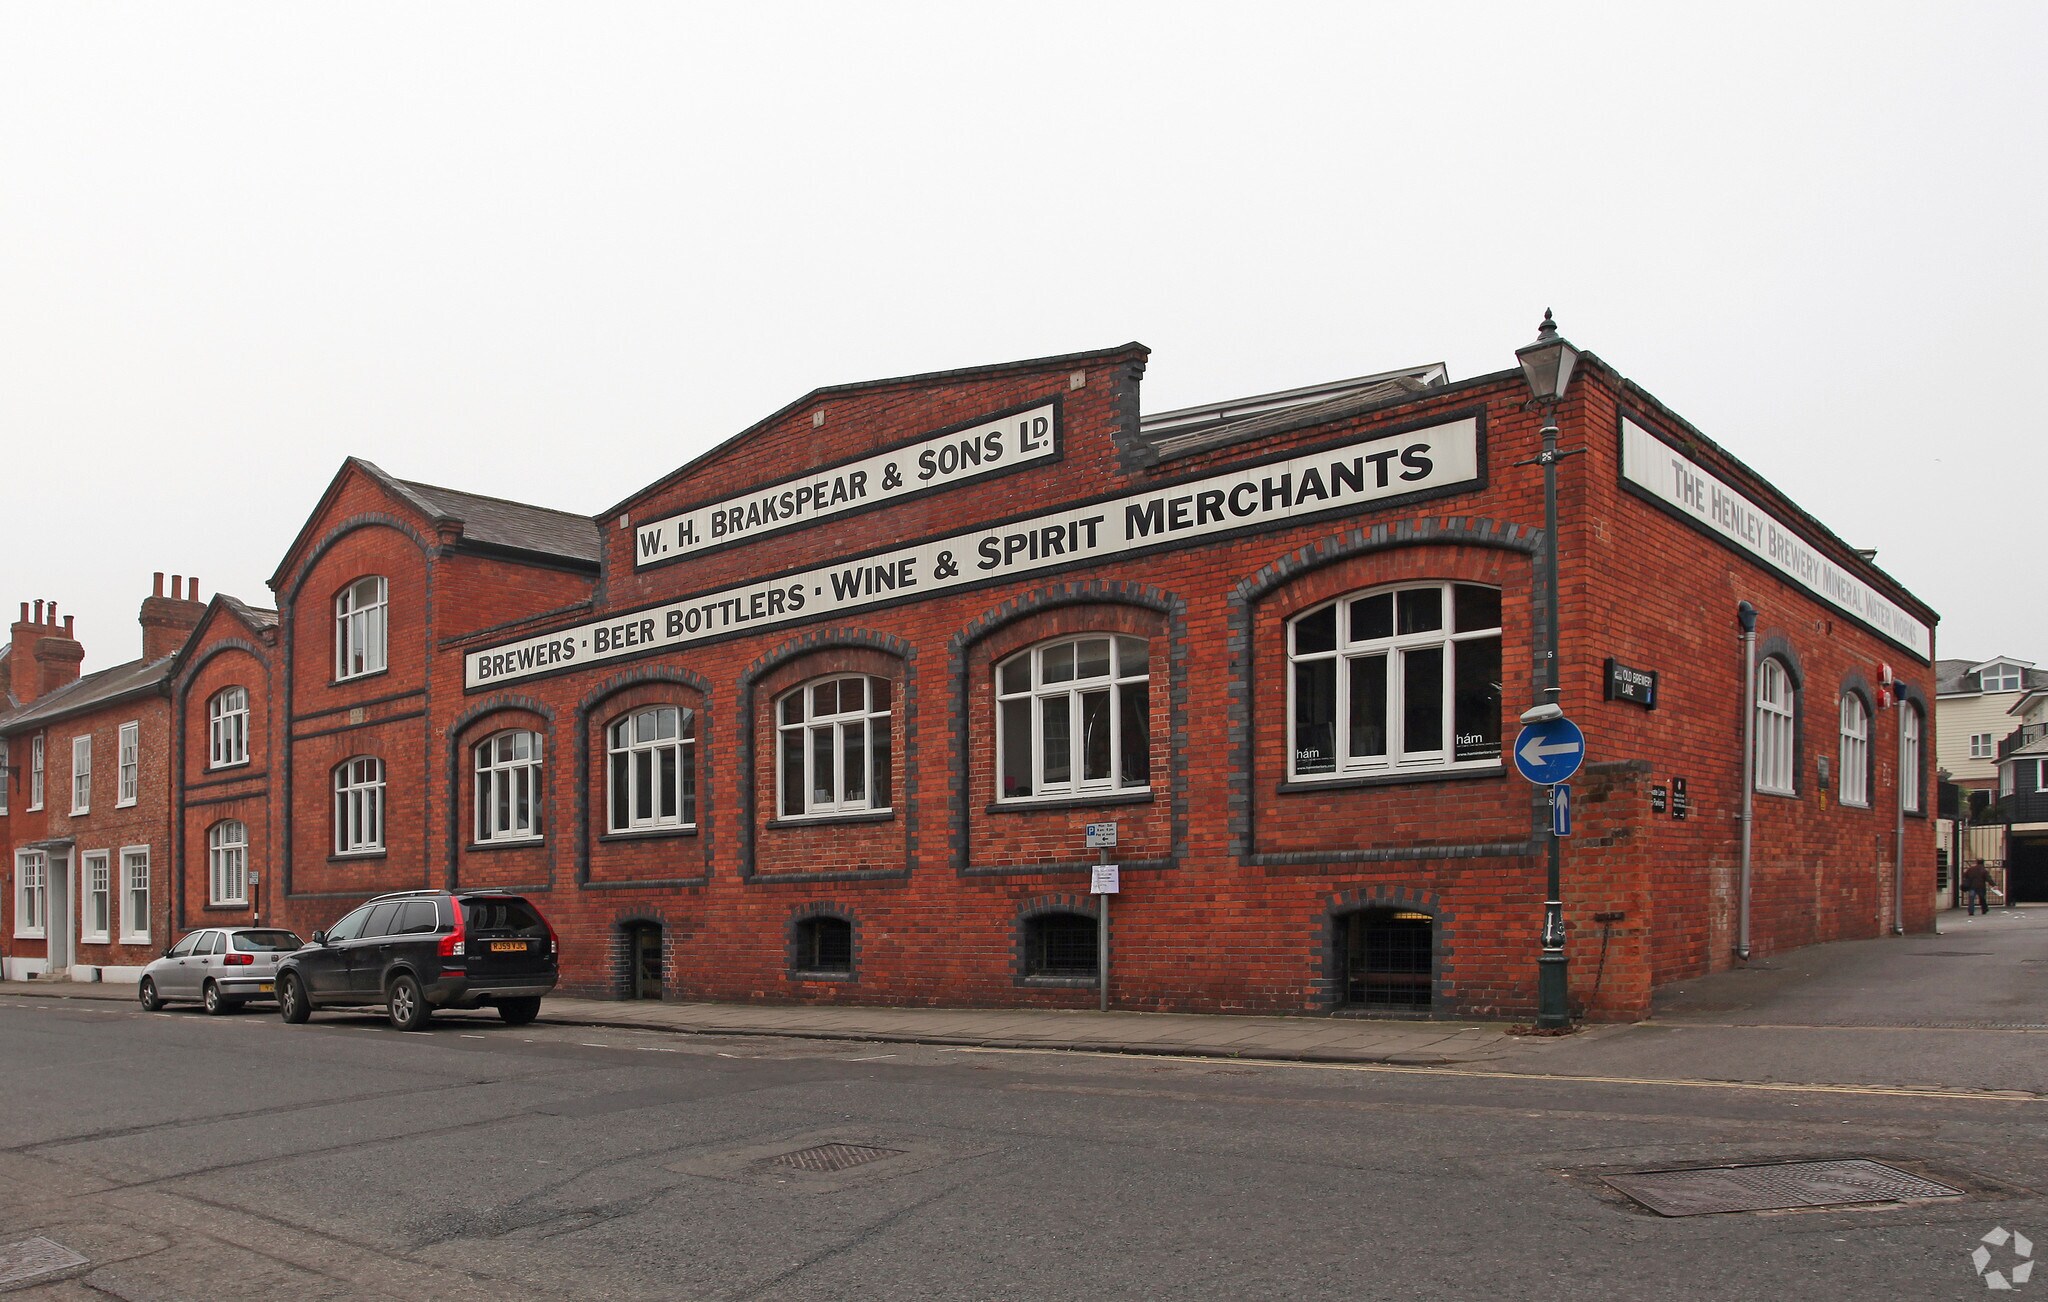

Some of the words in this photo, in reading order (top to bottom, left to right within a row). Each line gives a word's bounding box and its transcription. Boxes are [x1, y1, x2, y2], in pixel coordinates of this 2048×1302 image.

[640, 529, 667, 557] W.
[679, 519, 700, 547] H.
[712, 471, 867, 538] BRAKSPEAR
[882, 463, 903, 490] &
[918, 432, 1004, 480] SONS
[479, 638, 576, 679] BREWERS
[595, 619, 655, 653] BEER
[667, 584, 806, 638] BOTTLERS
[830, 557, 918, 601] WINE
[934, 551, 958, 580] &
[977, 515, 1105, 570] SPIRIT
[1126, 444, 1434, 540] MERCHANTS
[1672, 459, 1705, 513] THE
[1711, 485, 1763, 549] HENLEY
[1768, 524, 1820, 586] BREWERY
[1823, 564, 1863, 613] MINERAL
[1865, 591, 1891, 628] WATER
[1893, 609, 1917, 646] WORKS
[1622, 670, 1632, 682] OLD
[1632, 672, 1653, 688] BREWERY
[1622, 683, 1634, 696] LANE
[493, 942, 511, 950] RJ59
